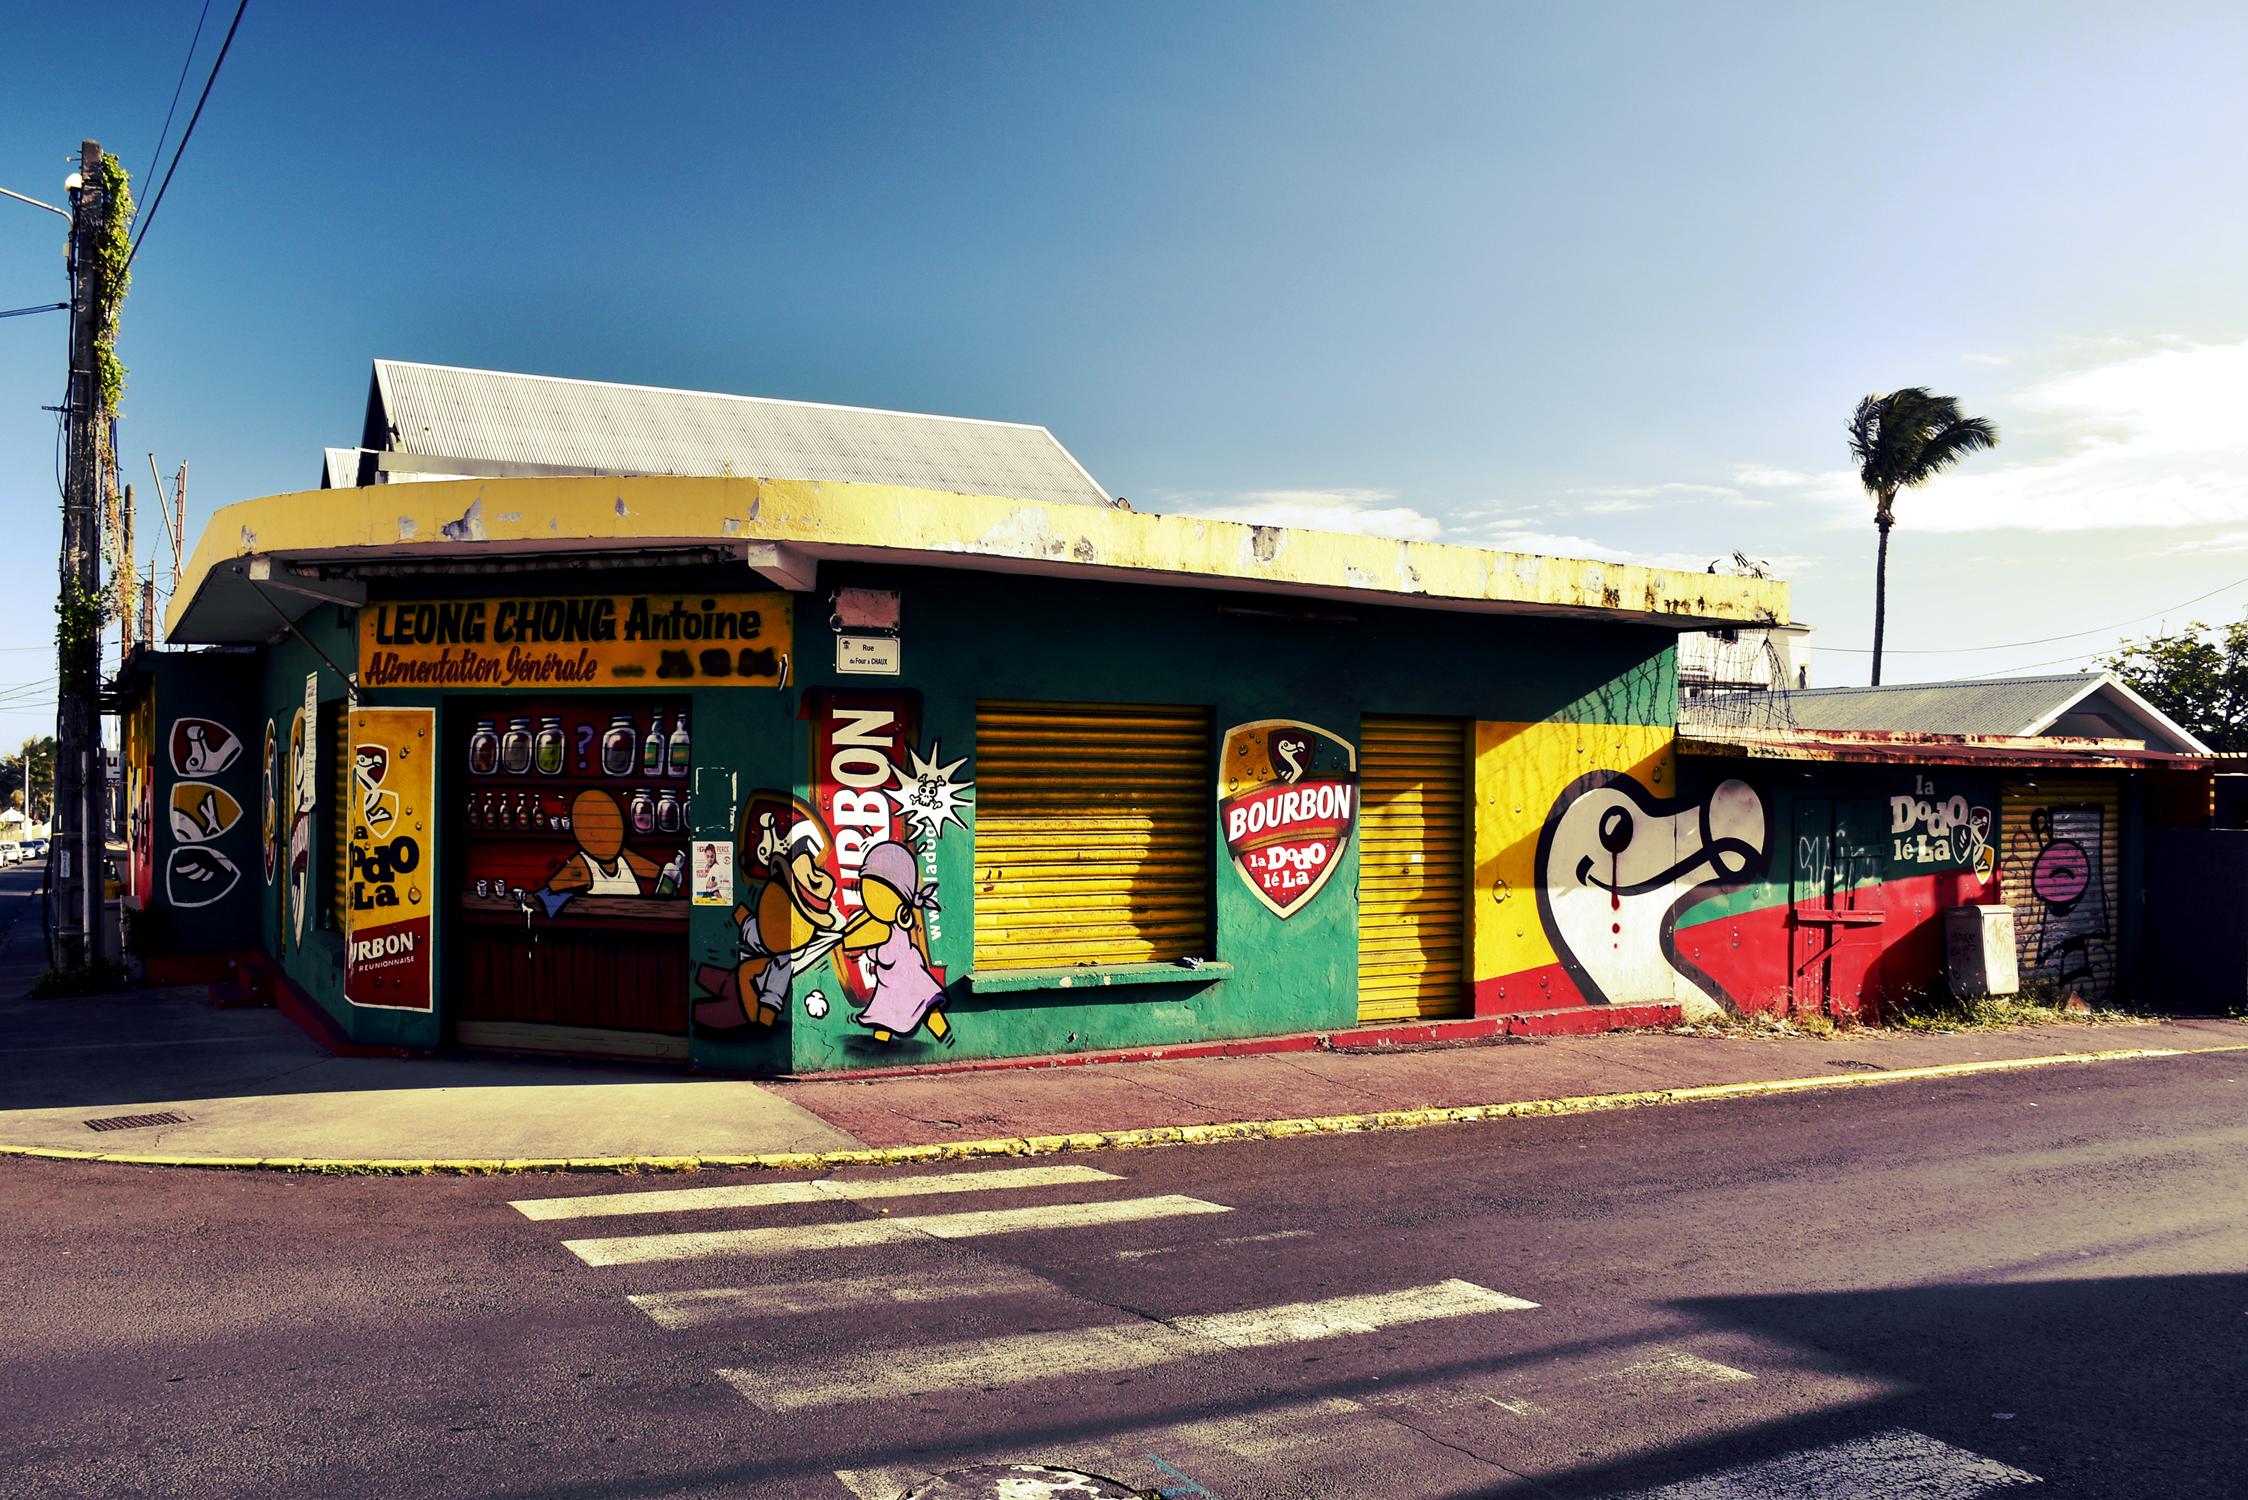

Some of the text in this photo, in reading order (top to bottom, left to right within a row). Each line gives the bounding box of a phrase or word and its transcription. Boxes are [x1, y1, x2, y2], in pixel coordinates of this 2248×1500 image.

[376, 597, 762, 645] LEONG CHONG Antoine
[862, 644, 875, 652] Rue
[365, 649, 501, 686] Alimentation
[500, 646, 598, 687] Générale
[855, 657, 867, 665] Four
[1915, 774, 1936, 795] la
[1228, 784, 1352, 843] BOURBON
[1893, 834, 1951, 863] lé La
[1250, 855, 1267, 868] la
[1263, 869, 1310, 888] lé La
